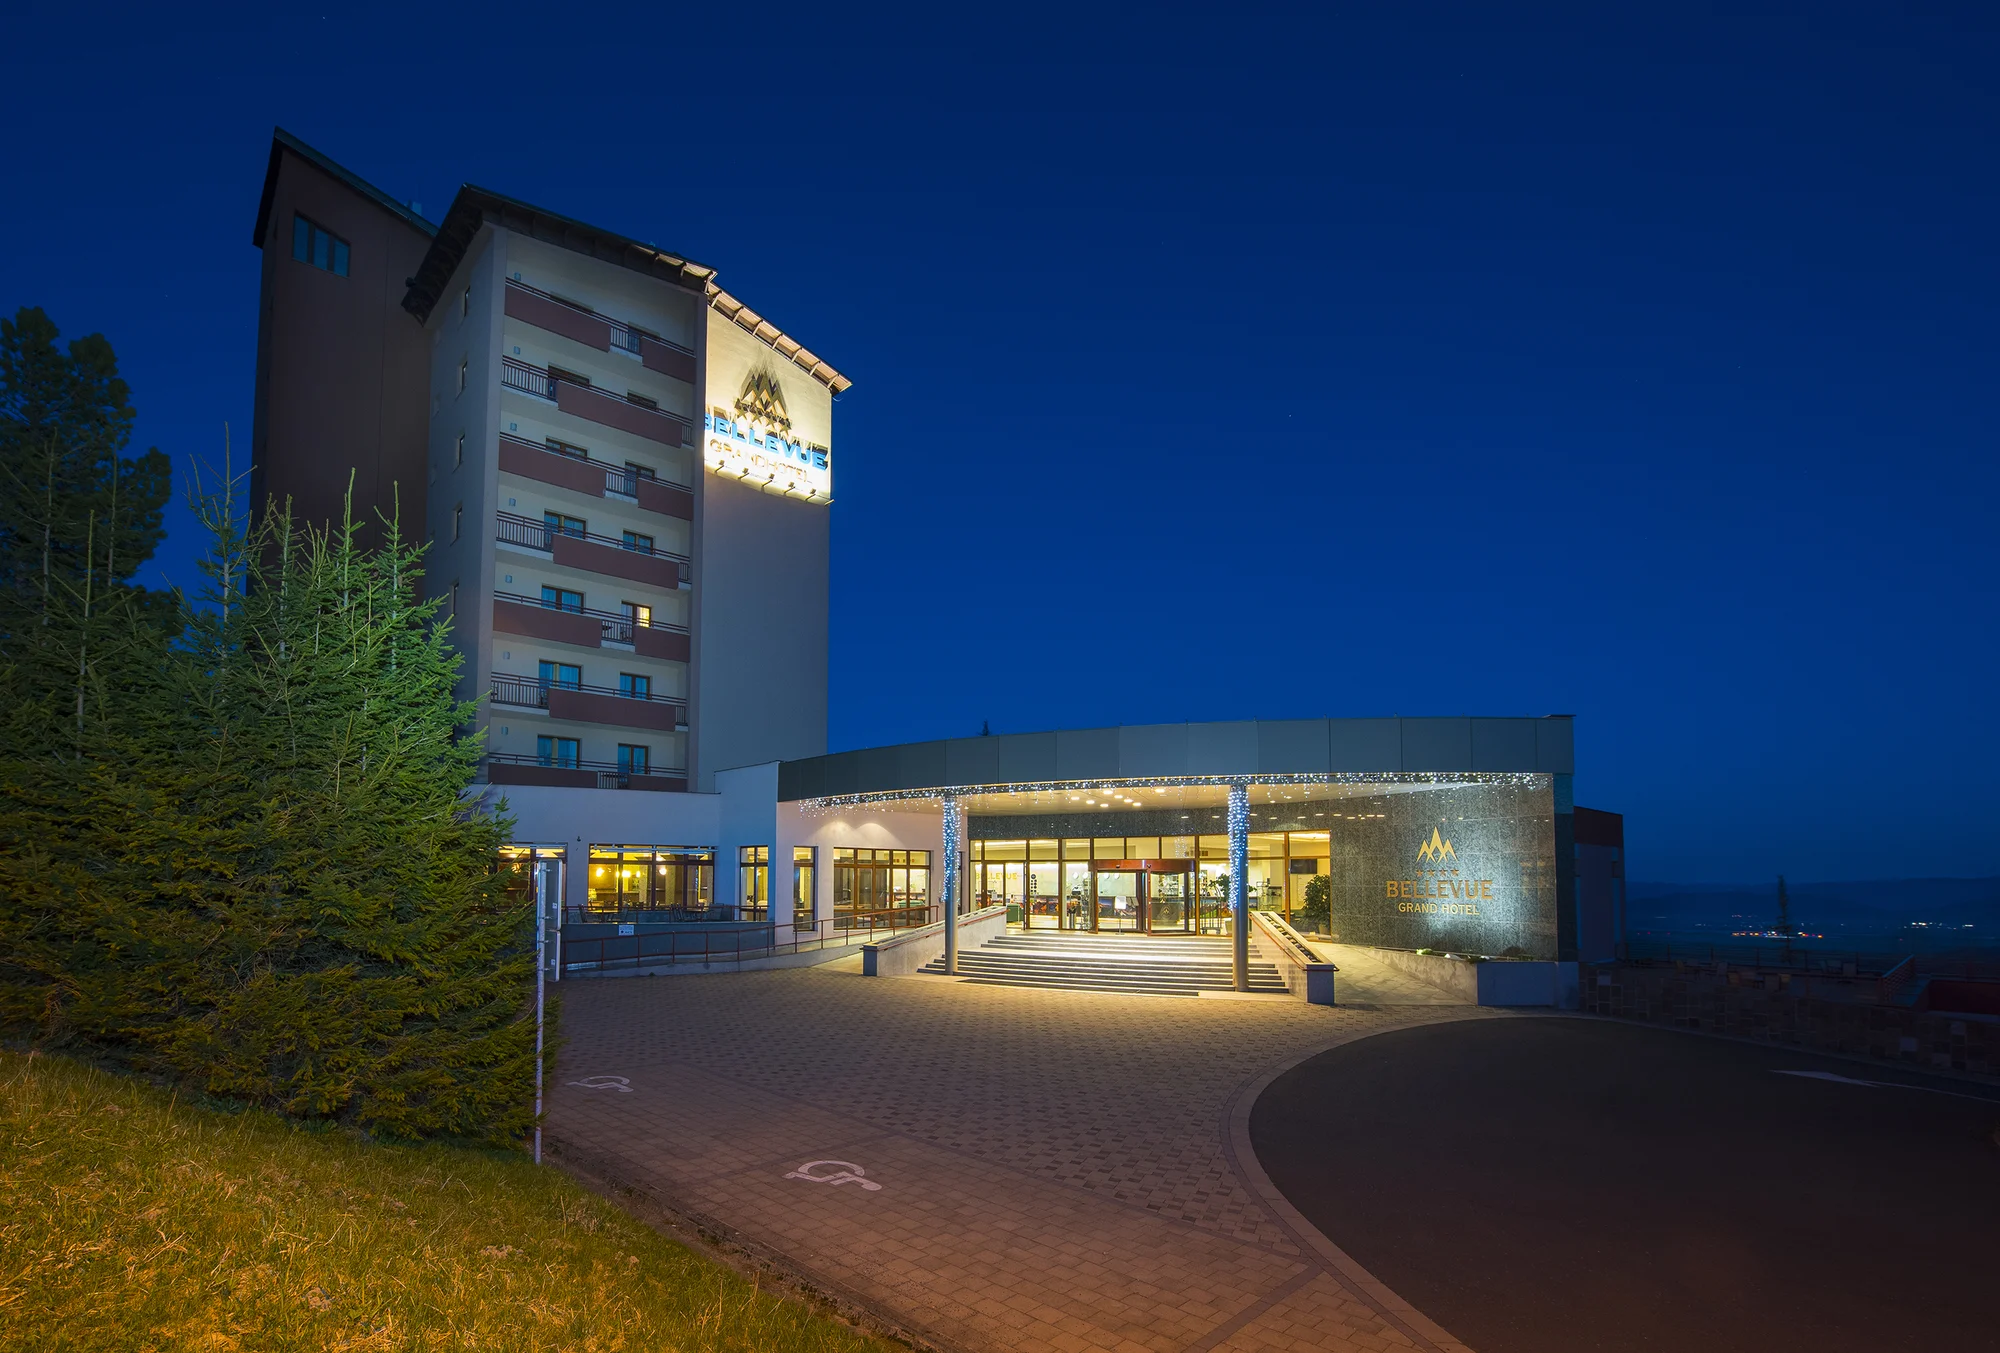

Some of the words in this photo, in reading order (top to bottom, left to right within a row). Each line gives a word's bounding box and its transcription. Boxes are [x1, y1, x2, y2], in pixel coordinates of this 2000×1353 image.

[1386, 880, 1493, 900] BELLEVUE
[1398, 902, 1438, 914] GRAND
[1441, 904, 1480, 915] HOTEL
